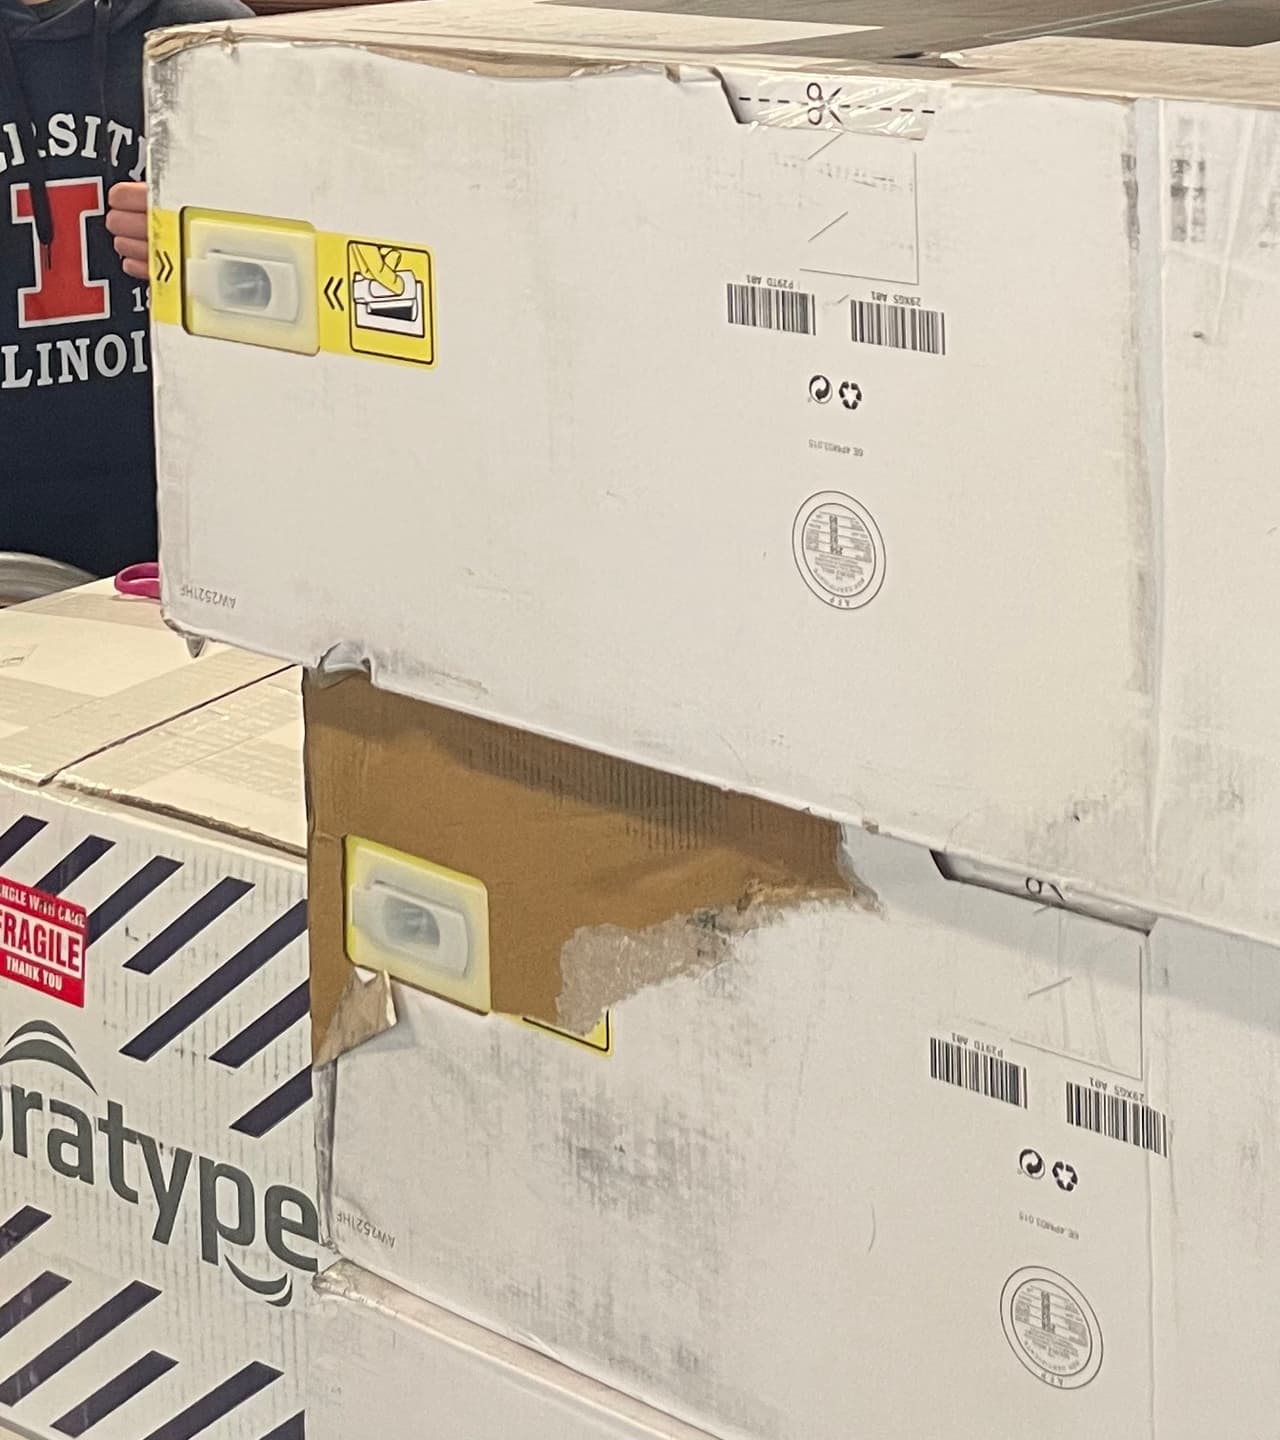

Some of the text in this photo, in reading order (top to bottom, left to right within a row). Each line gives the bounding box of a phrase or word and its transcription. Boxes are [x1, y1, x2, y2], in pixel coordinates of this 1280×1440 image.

[29, 893, 56, 917] WITH
[58, 905, 86, 929] CARE
[6, 955, 63, 991] THANK YOU
